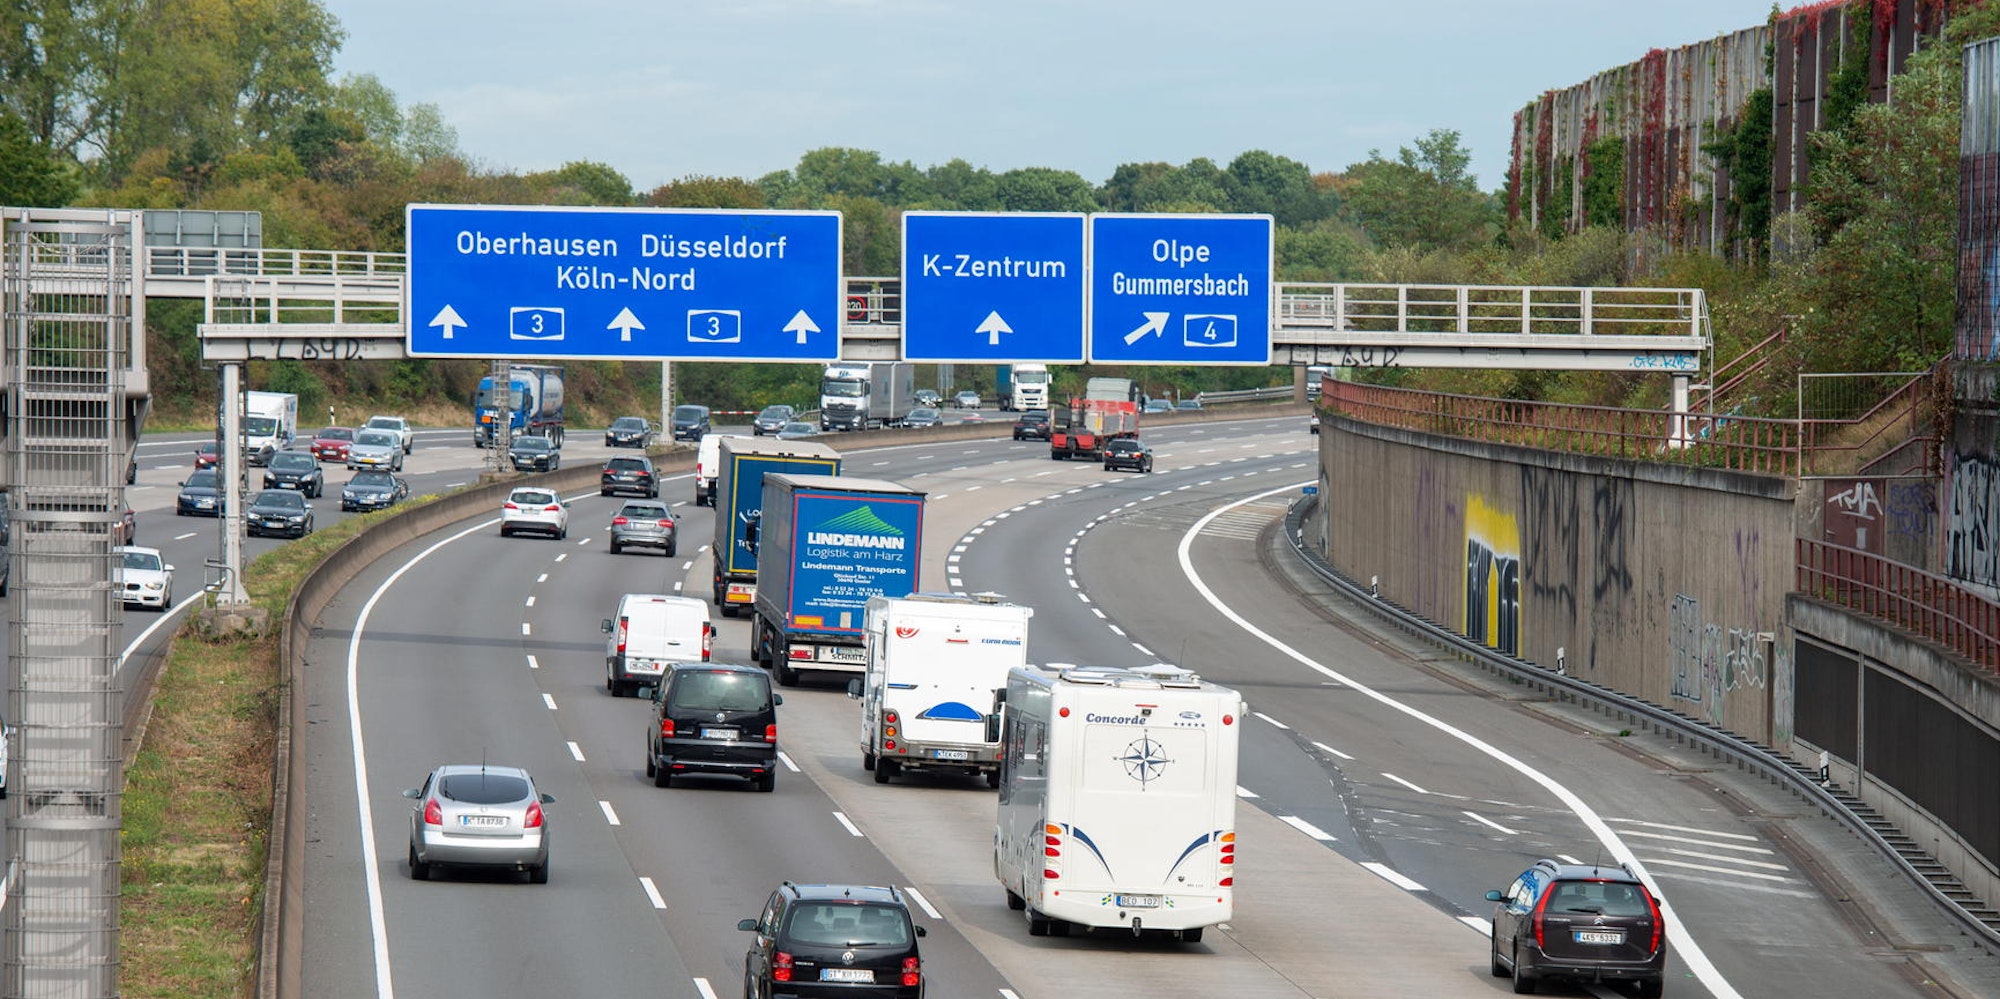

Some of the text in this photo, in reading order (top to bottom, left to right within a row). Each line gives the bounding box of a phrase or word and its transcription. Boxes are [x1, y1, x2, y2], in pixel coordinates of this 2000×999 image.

[457, 230, 787, 259] Oberhausen Düsseldorf
[1152, 239, 1210, 268] Olpe
[923, 254, 1066, 278] K-Zentrum
[556, 265, 695, 291] Köln-Nord
[1113, 271, 1249, 297] Gummersbach
[530, 314, 543, 334] 3
[707, 317, 720, 336] 3
[1204, 321, 1217, 340] 4
[807, 532, 905, 550] LINDEMANN
[806, 547, 904, 562] Logistik am Harz
[802, 561, 907, 575] Lindemann Transporte
[1086, 713, 1147, 726] Concorde
